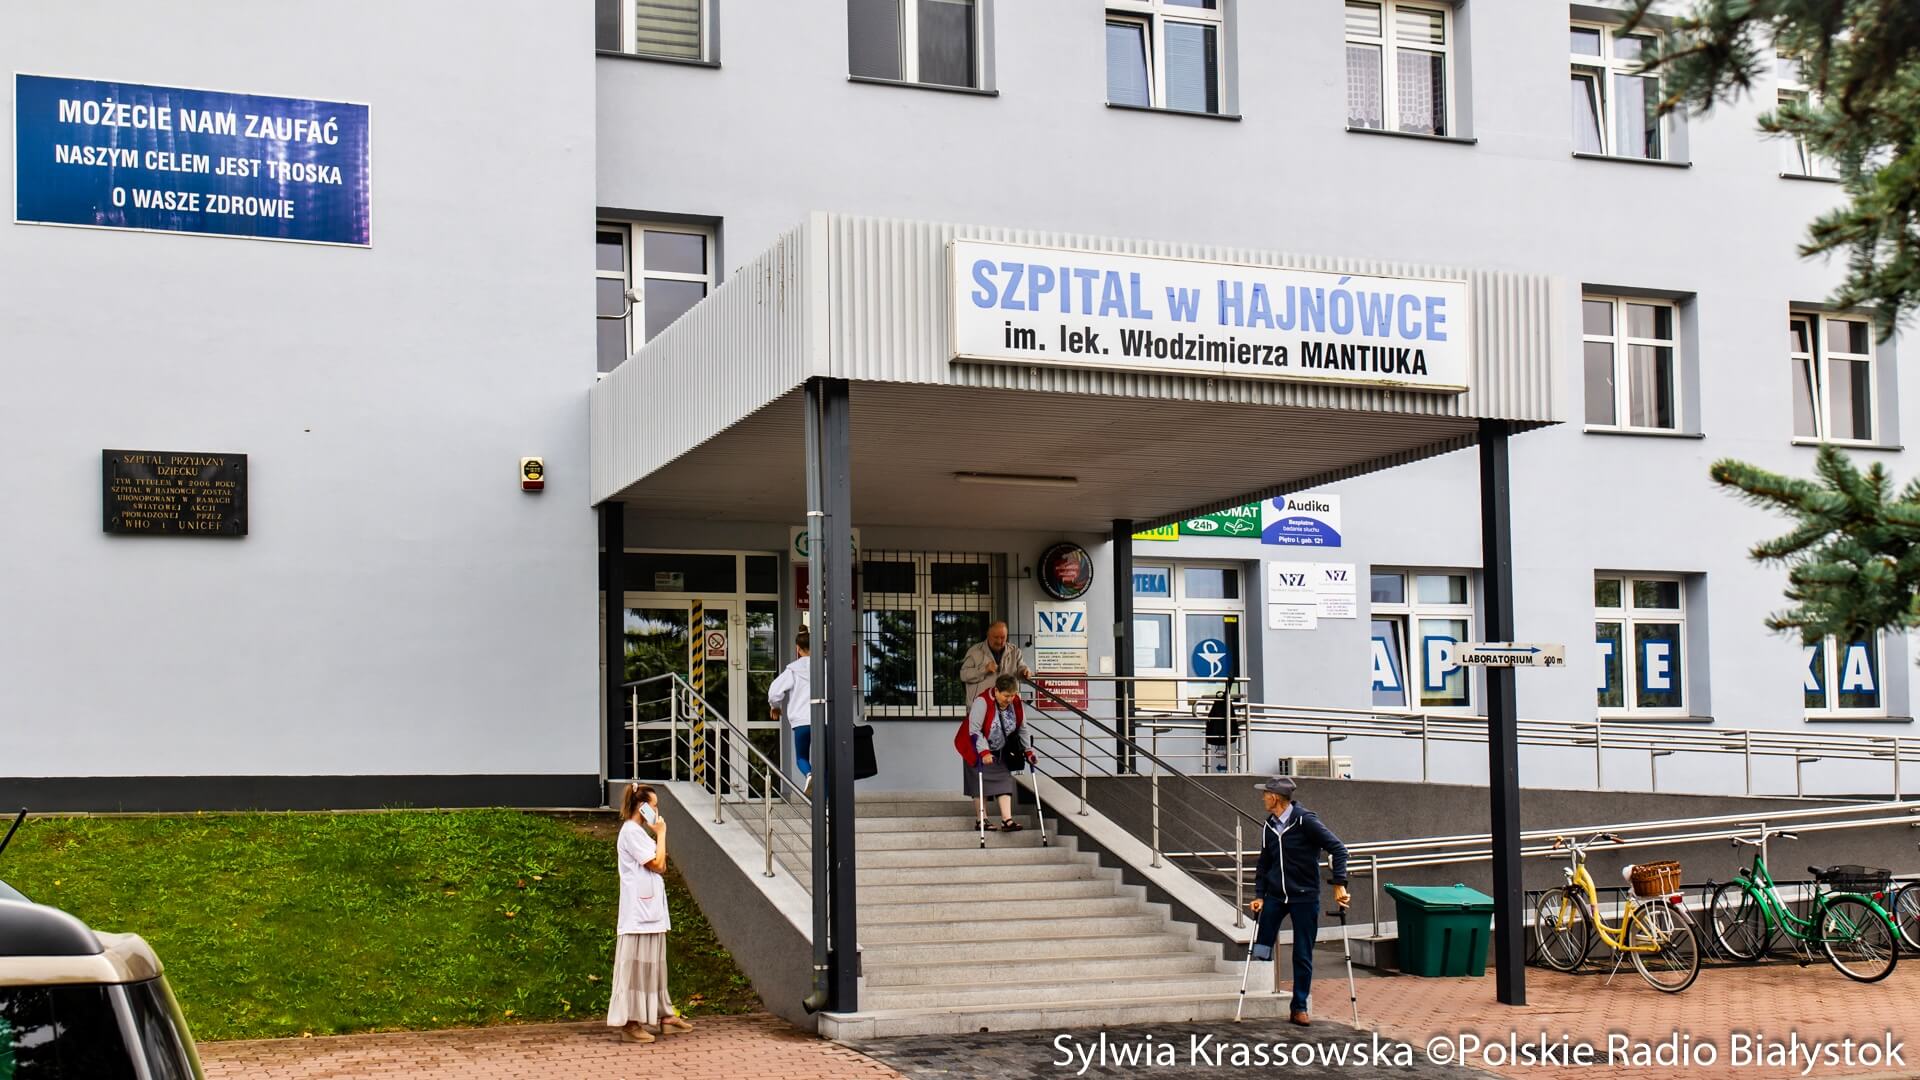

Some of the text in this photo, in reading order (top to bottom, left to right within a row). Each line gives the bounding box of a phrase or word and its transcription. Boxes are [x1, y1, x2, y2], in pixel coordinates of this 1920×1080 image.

[58, 97, 339, 145] MOŻECIE NAM ZAUFAĆ
[55, 144, 342, 185] NASZYM CELEM JEST TROSKA
[112, 187, 295, 219] O WASZE ZDROWIE
[971, 259, 1153, 320] SZPITAL
[1218, 277, 1447, 342] HAJNÓWCE
[1005, 321, 1428, 376] im. lek. Włodzimierza MANTIUKA
[123, 455, 225, 466] SZPITAL PRZYJAZNY
[157, 466, 198, 476] DZIECKU
[215, 480, 236, 488] ROKU
[1287, 500, 1330, 513] Audika
[125, 519, 150, 528] WHO
[178, 520, 222, 530] UNICEF
[1193, 521, 1213, 530] 24h
[1279, 573, 1306, 587] NFZ
[1325, 569, 1348, 581] NFZ
[1132, 574, 1167, 593] TEKA
[1037, 611, 1085, 633] NFZ
[1462, 654, 1533, 664] LABORATORIUM
